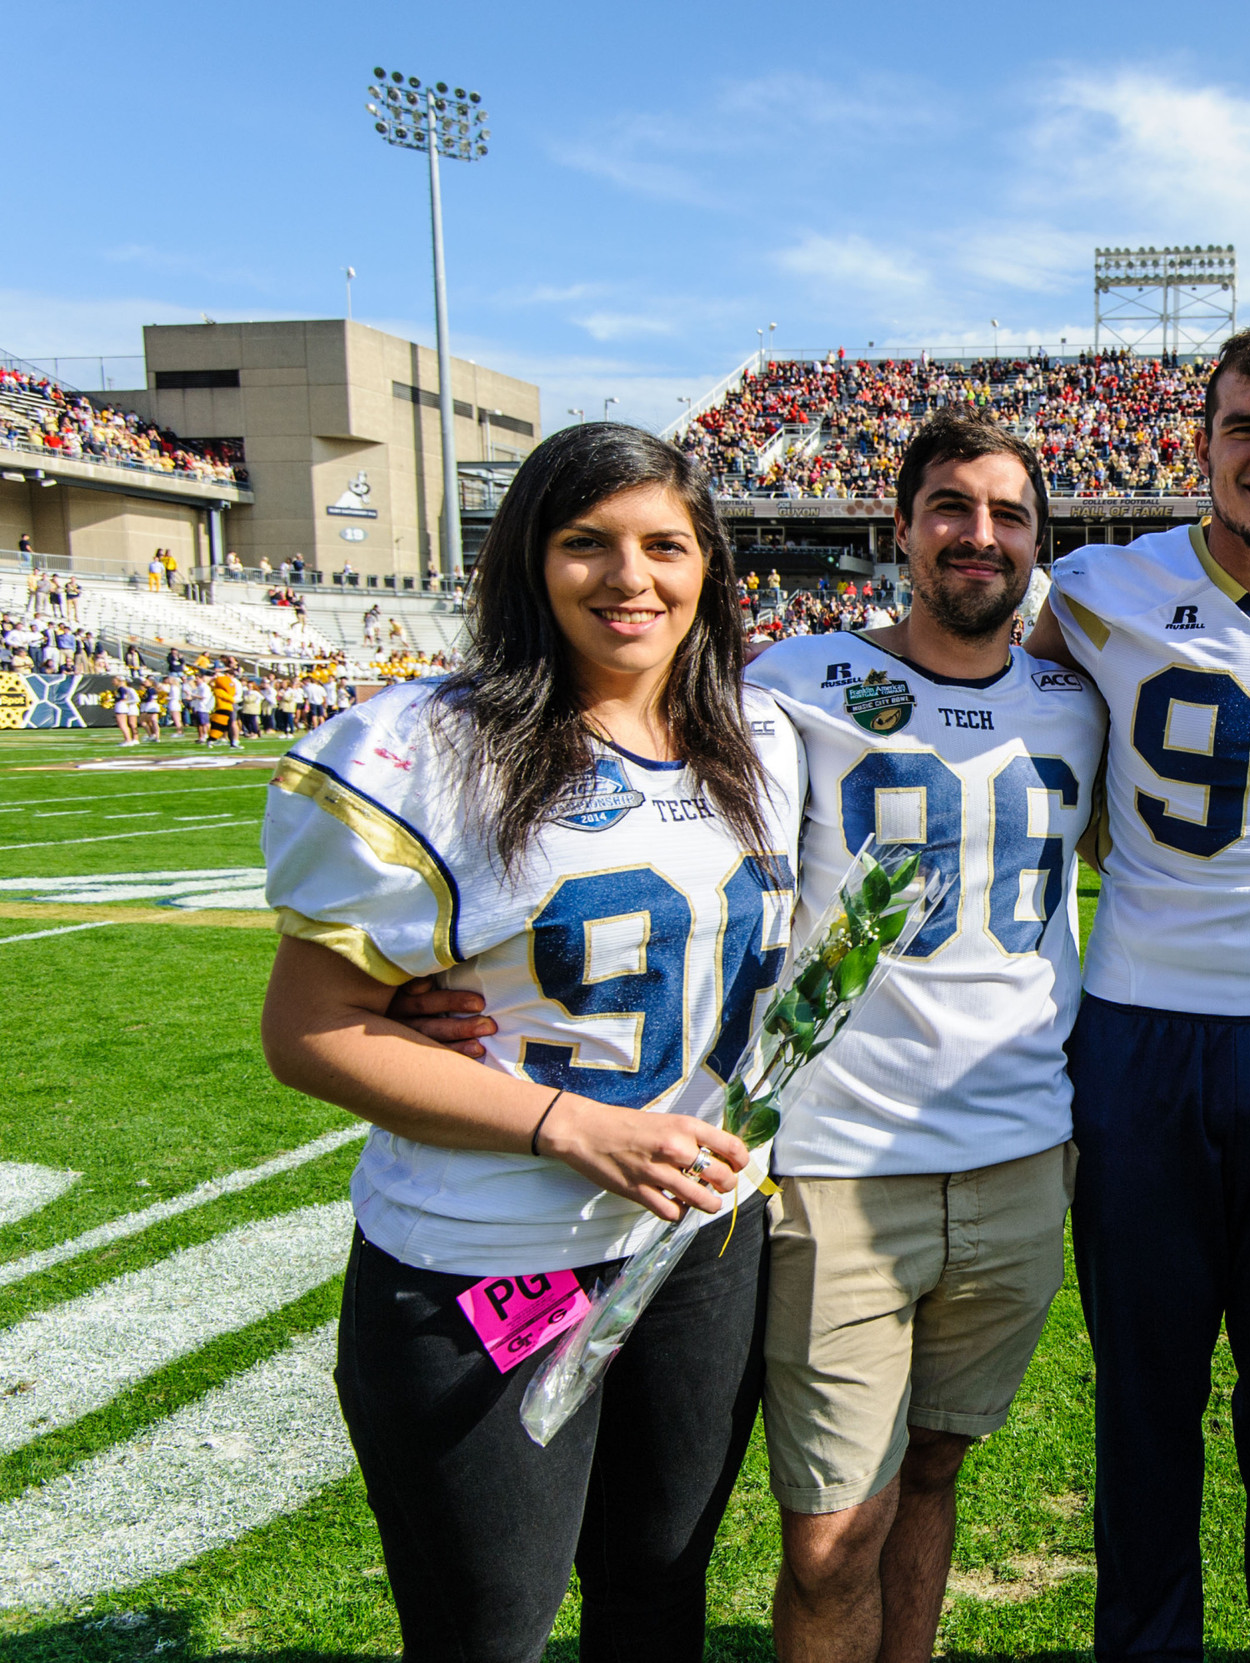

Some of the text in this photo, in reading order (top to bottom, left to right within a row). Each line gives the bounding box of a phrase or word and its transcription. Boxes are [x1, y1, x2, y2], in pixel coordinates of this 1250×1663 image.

[777, 507, 820, 517] GUYON
[1070, 506, 1106, 517] HALL
[1109, 506, 1128, 517] OF
[1131, 506, 1174, 517] FAME
[1172, 605, 1199, 624] R
[826, 662, 851, 681] R
[1040, 673, 1079, 686] ACC
[821, 676, 864, 689] RUSSELL
[853, 702, 873, 711] MUSIC
[891, 695, 909, 703] BOWL
[938, 707, 995, 730] TECH
[751, 720, 775, 735] CC
[581, 812, 607, 824] 2014
[652, 798, 715, 823] TECH
[837, 748, 1079, 961] 96
[515, 851, 794, 1110] 96
[484, 1273, 552, 1322] PG
[547, 1308, 568, 1325] G
